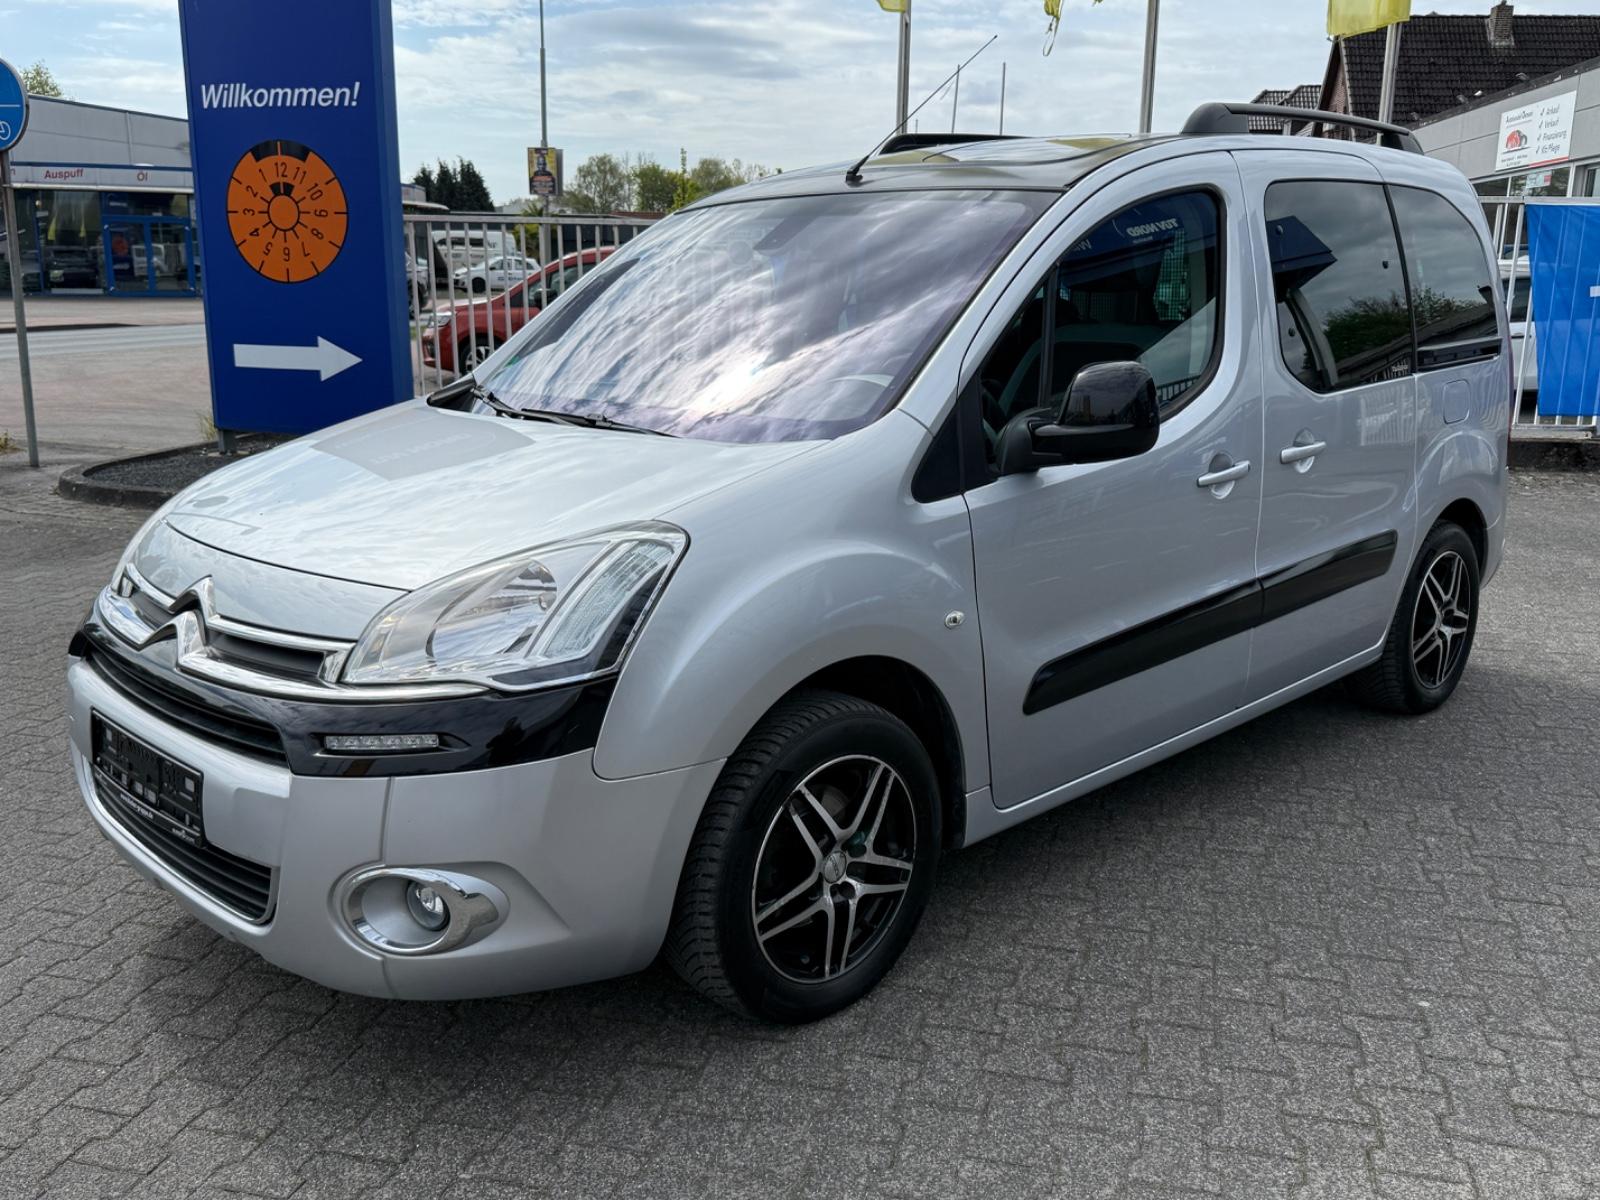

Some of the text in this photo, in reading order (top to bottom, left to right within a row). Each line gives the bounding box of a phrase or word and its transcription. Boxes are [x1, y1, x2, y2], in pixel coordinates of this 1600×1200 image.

[201, 81, 360, 109] Willkommen!
[44, 168, 84, 180] Auspuff
[136, 169, 148, 182] Öl
[258, 168, 267, 182] 1
[274, 162, 288, 178] 12
[293, 166, 307, 185] 11
[245, 185, 258, 198] 2
[307, 183, 324, 201] 10
[242, 207, 256, 216] 3
[249, 228, 260, 237] 4
[311, 227, 325, 240] 8
[263, 241, 273, 256] 5
[301, 241, 310, 257] 7
